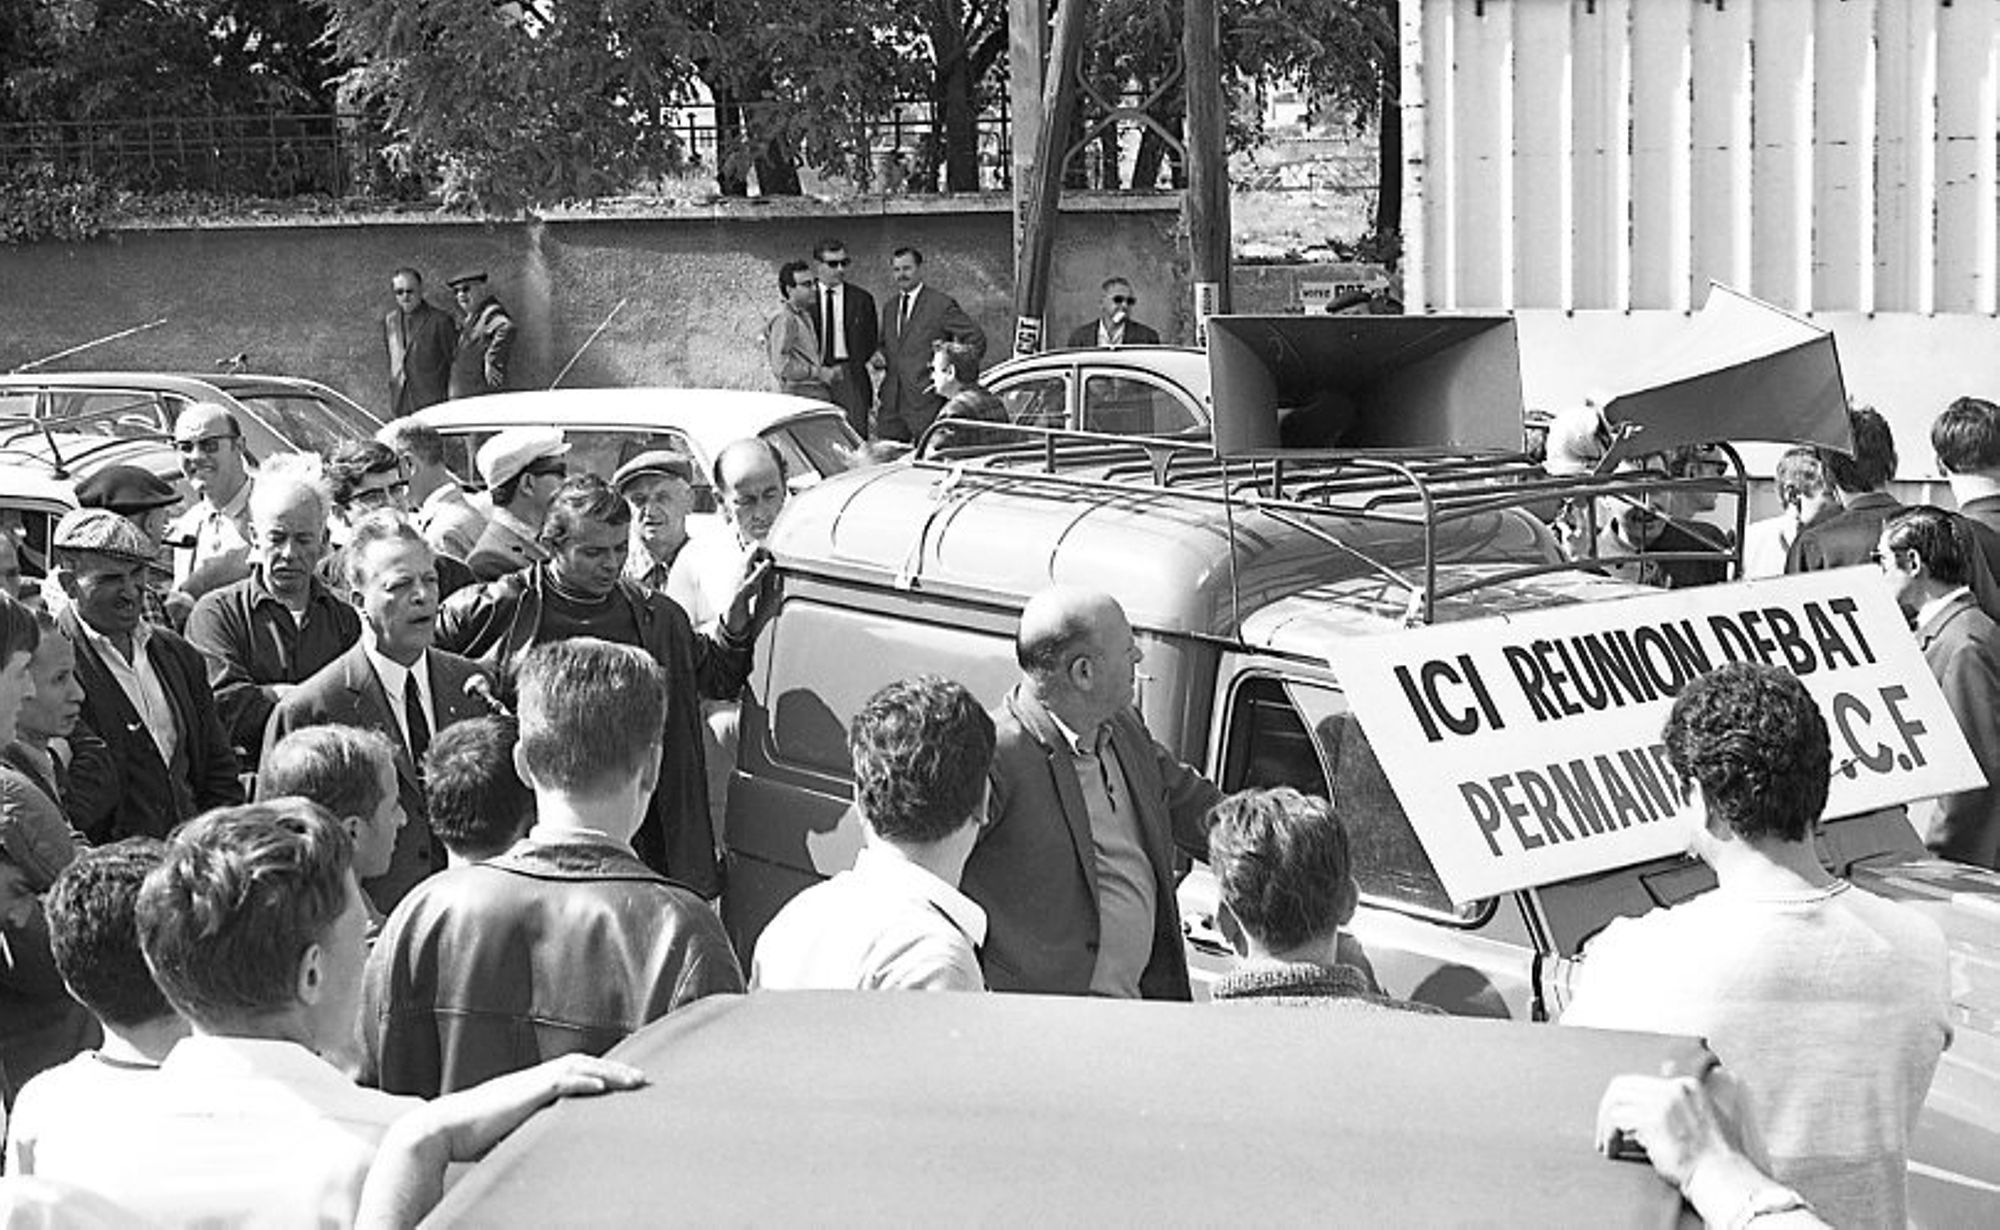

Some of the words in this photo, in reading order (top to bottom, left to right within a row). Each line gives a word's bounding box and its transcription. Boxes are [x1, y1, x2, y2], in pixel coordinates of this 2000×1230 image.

[1393, 653, 1505, 742] ICI
[1501, 619, 1713, 722] REUNION
[1707, 597, 1876, 676] DEBAT
[1833, 684, 1928, 780] .C.F
